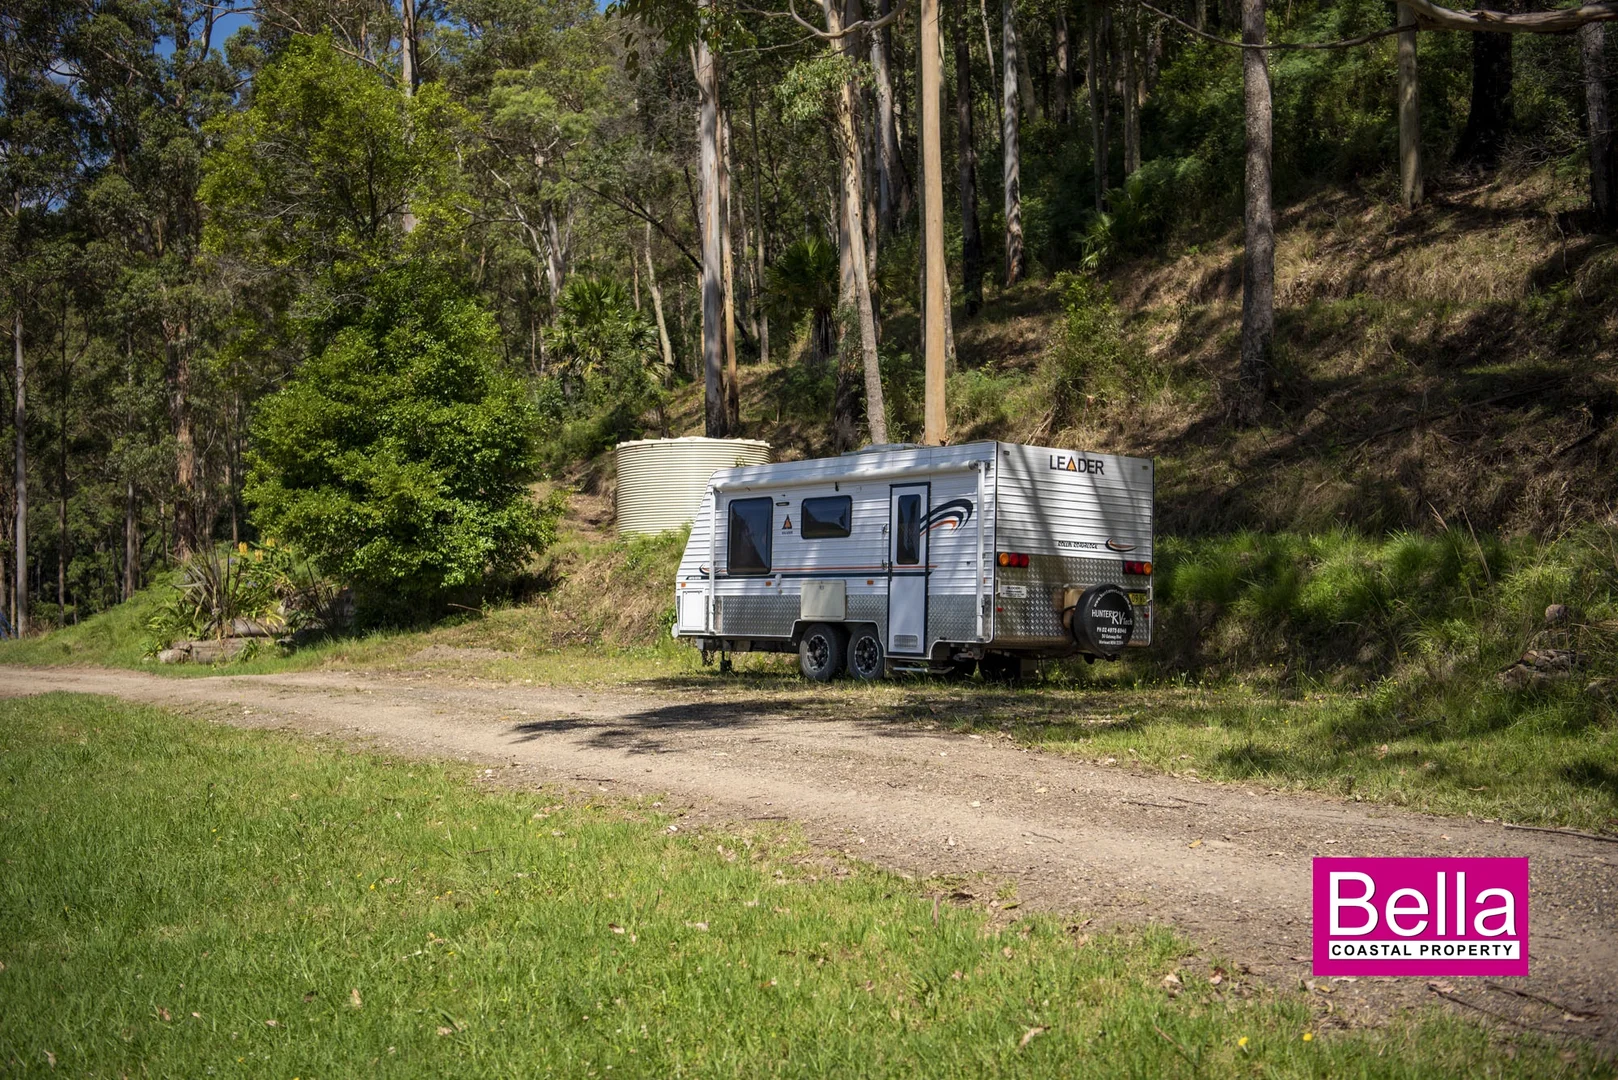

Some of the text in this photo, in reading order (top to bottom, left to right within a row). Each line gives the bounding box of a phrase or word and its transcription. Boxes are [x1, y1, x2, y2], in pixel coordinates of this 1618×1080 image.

[1049, 454, 1105, 475] LEADER
[1092, 610, 1112, 618] HUNTER
[1111, 610, 1125, 625] RV
